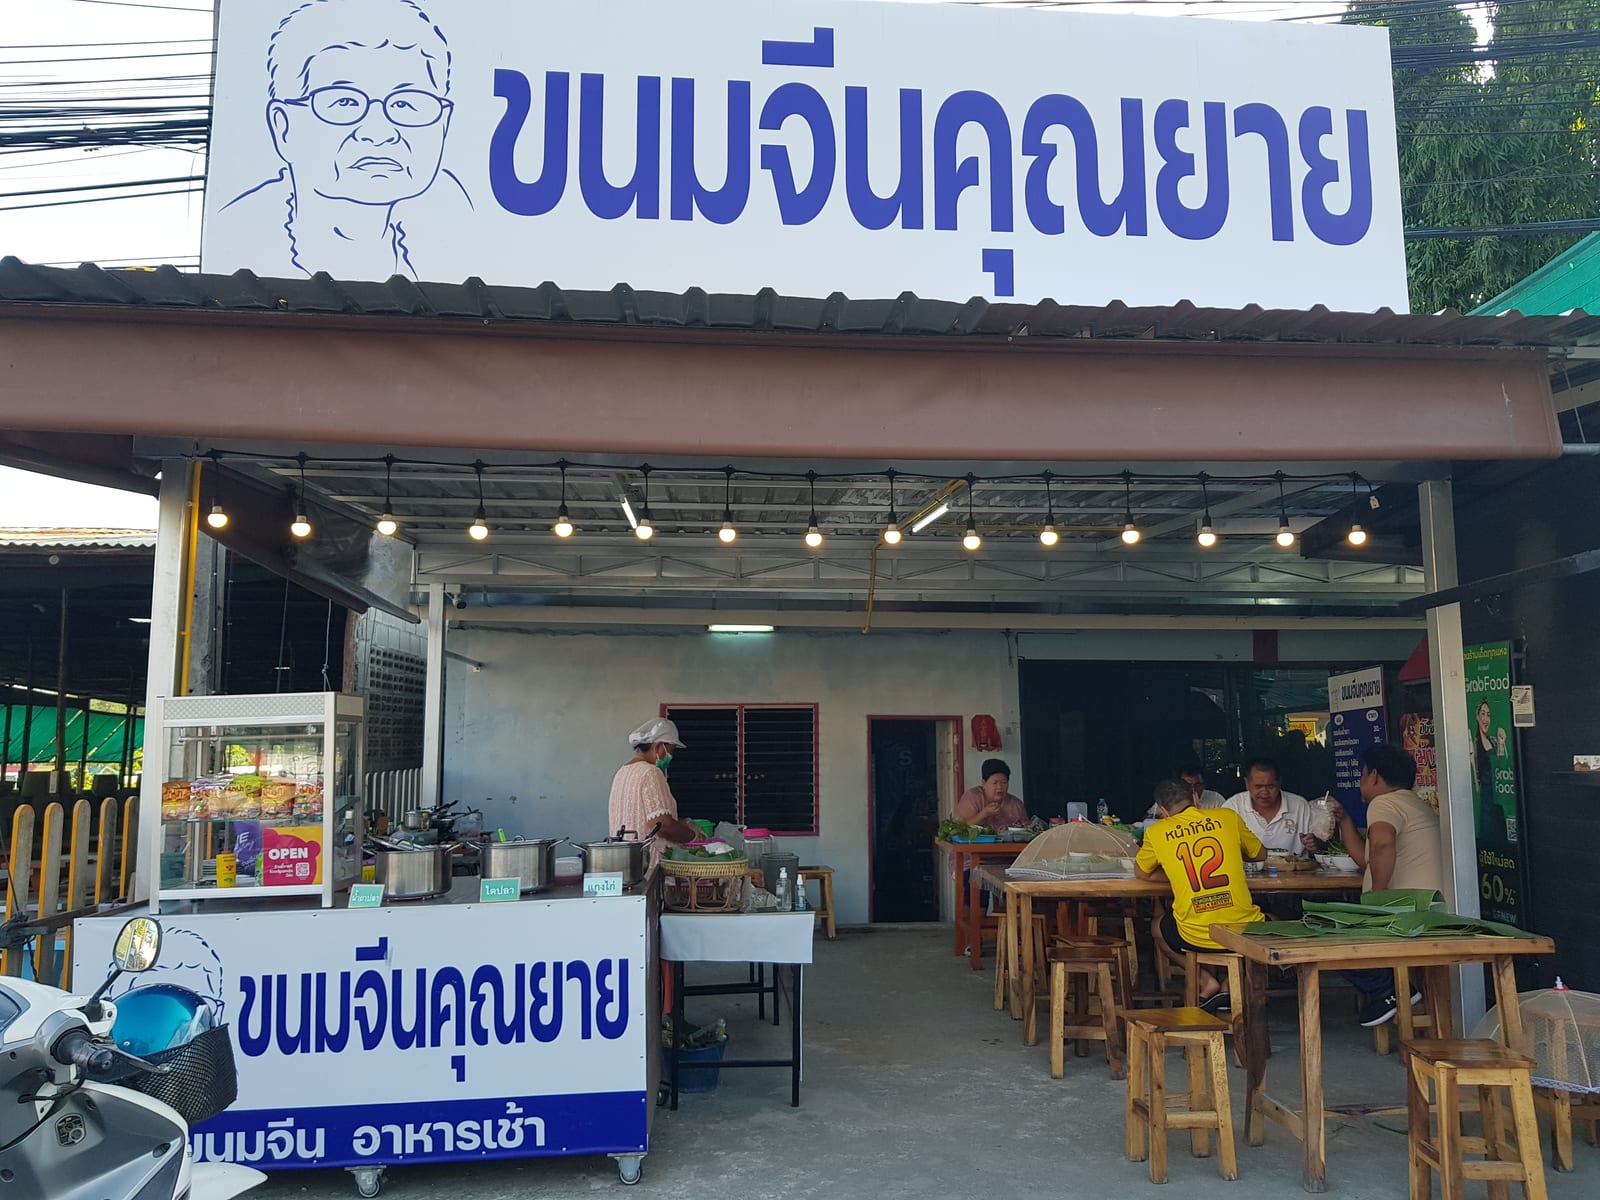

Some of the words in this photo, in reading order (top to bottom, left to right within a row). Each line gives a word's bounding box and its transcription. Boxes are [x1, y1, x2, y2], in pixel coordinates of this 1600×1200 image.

[489, 27, 1373, 297] ขนมจีนคุณยาย
[1495, 767, 1514, 780] Grab
[268, 847, 308, 860] OPEN
[1176, 836, 1229, 892] 12
[587, 879, 616, 892] แกงไก่
[238, 937, 629, 1082] ขนมจีนคุณยาย
[352, 1102, 546, 1156] อาหารเช้า
